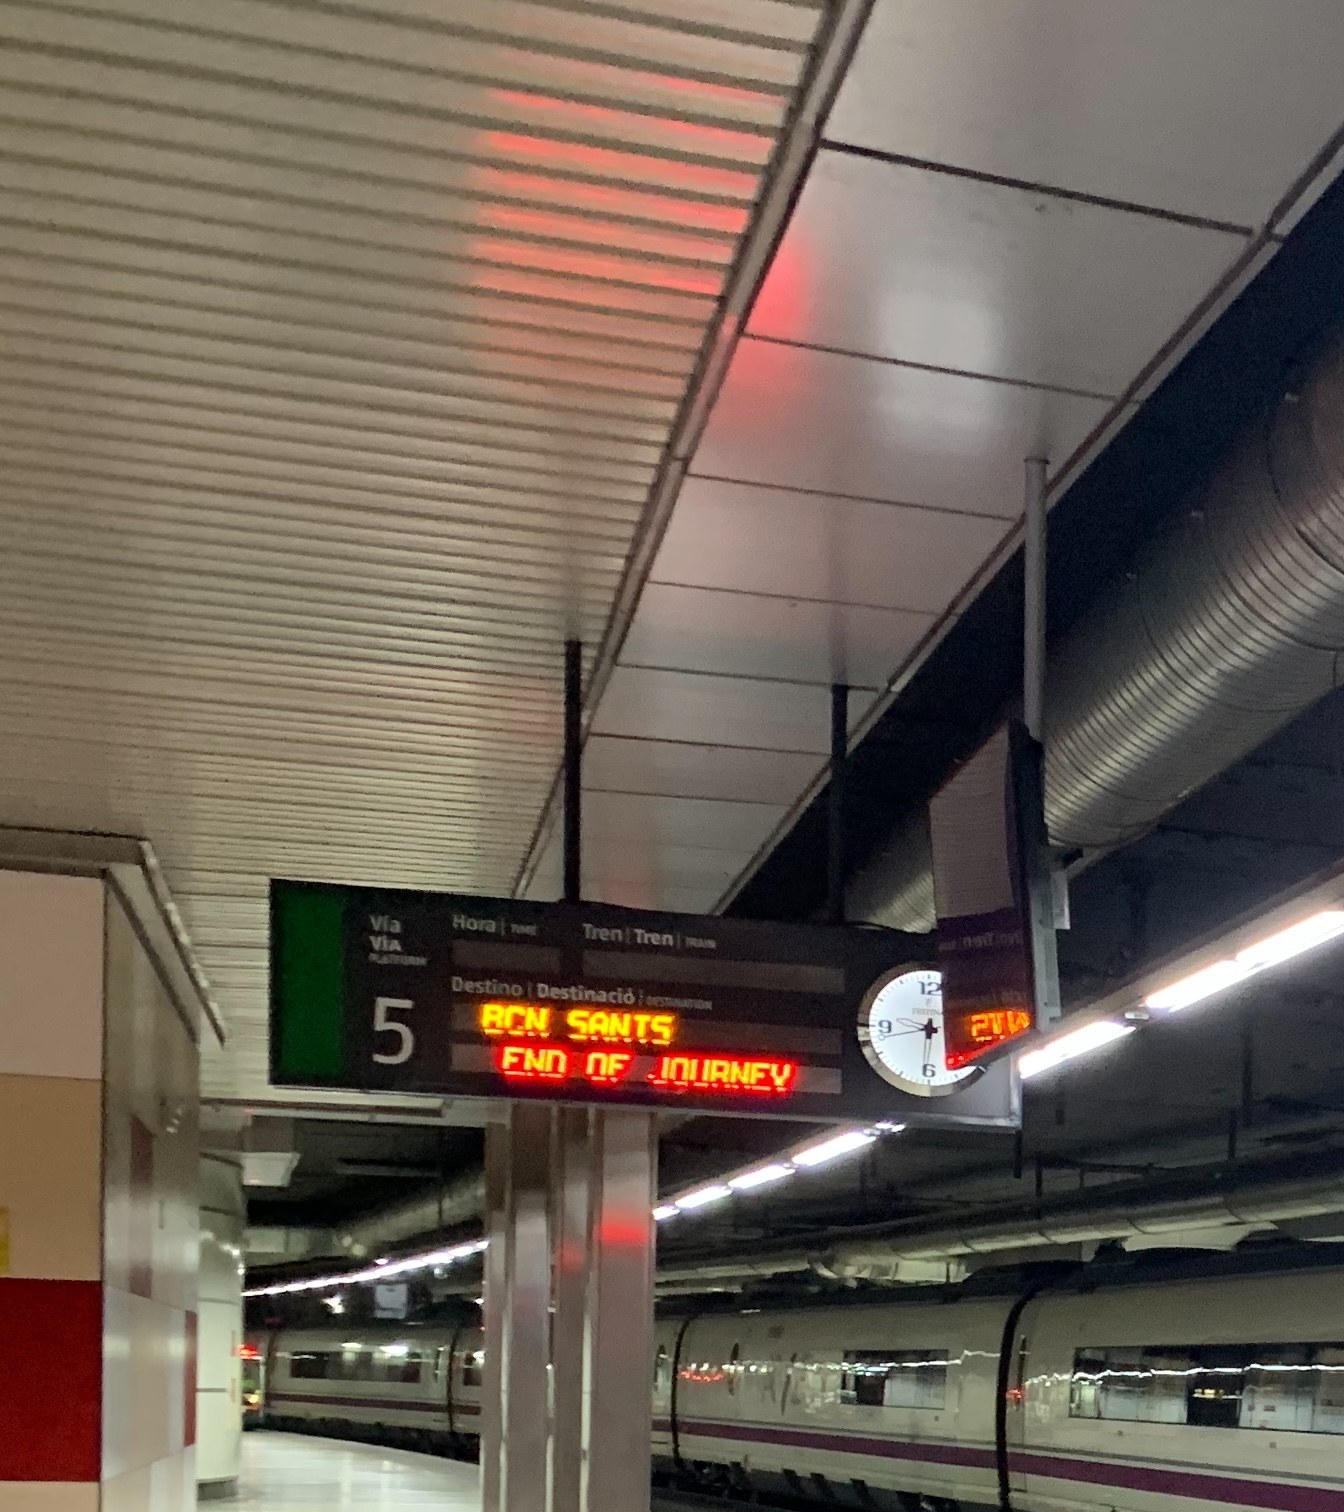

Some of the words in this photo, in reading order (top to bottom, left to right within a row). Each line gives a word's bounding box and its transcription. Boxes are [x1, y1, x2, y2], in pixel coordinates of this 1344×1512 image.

[451, 914, 496, 933] Hora
[583, 923, 623, 942] Tren
[633, 928, 674, 946] Tren
[451, 976, 523, 996] Destino
[536, 983, 635, 1005] Destinació
[917, 981, 942, 996] 12
[373, 997, 415, 1065] 5
[482, 1003, 550, 1037] BCN
[567, 1009, 674, 1045] SANTS
[878, 1020, 892, 1034] 9
[502, 1046, 568, 1079] END
[586, 1052, 631, 1082] OF
[648, 1056, 793, 1092] JOURNEY
[922, 1063, 936, 1078] 6
